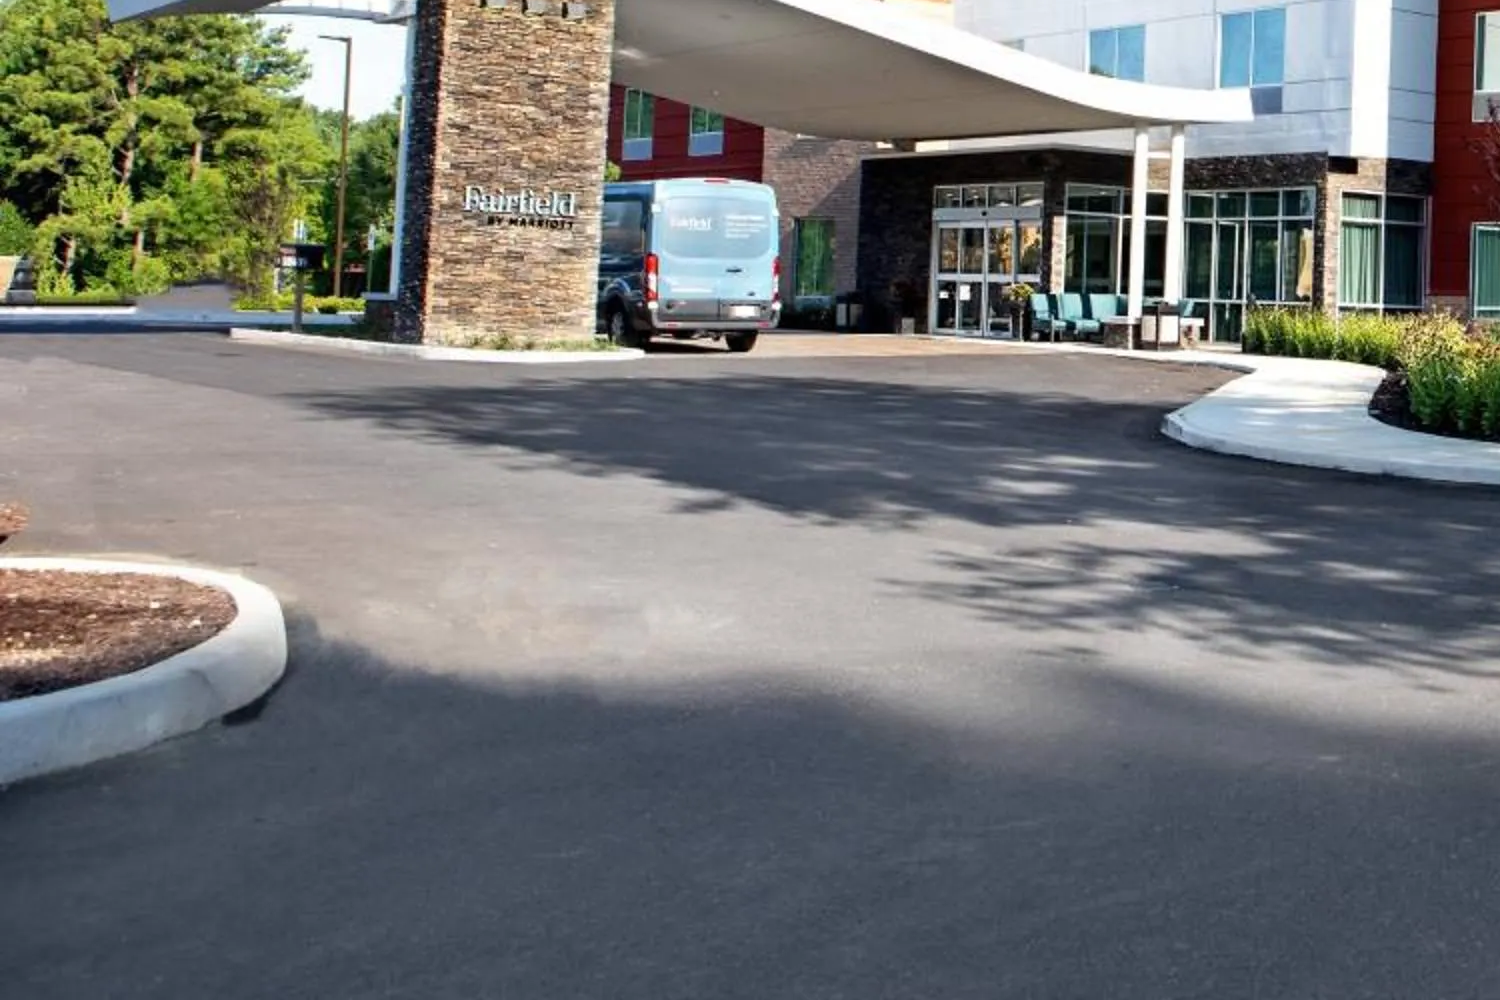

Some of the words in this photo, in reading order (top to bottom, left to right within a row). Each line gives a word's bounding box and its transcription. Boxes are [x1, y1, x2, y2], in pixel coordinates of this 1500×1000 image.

[463, 185, 576, 219] Fairfield
[487, 215, 502, 226] BY
[508, 216, 574, 230] MARRIOTT
